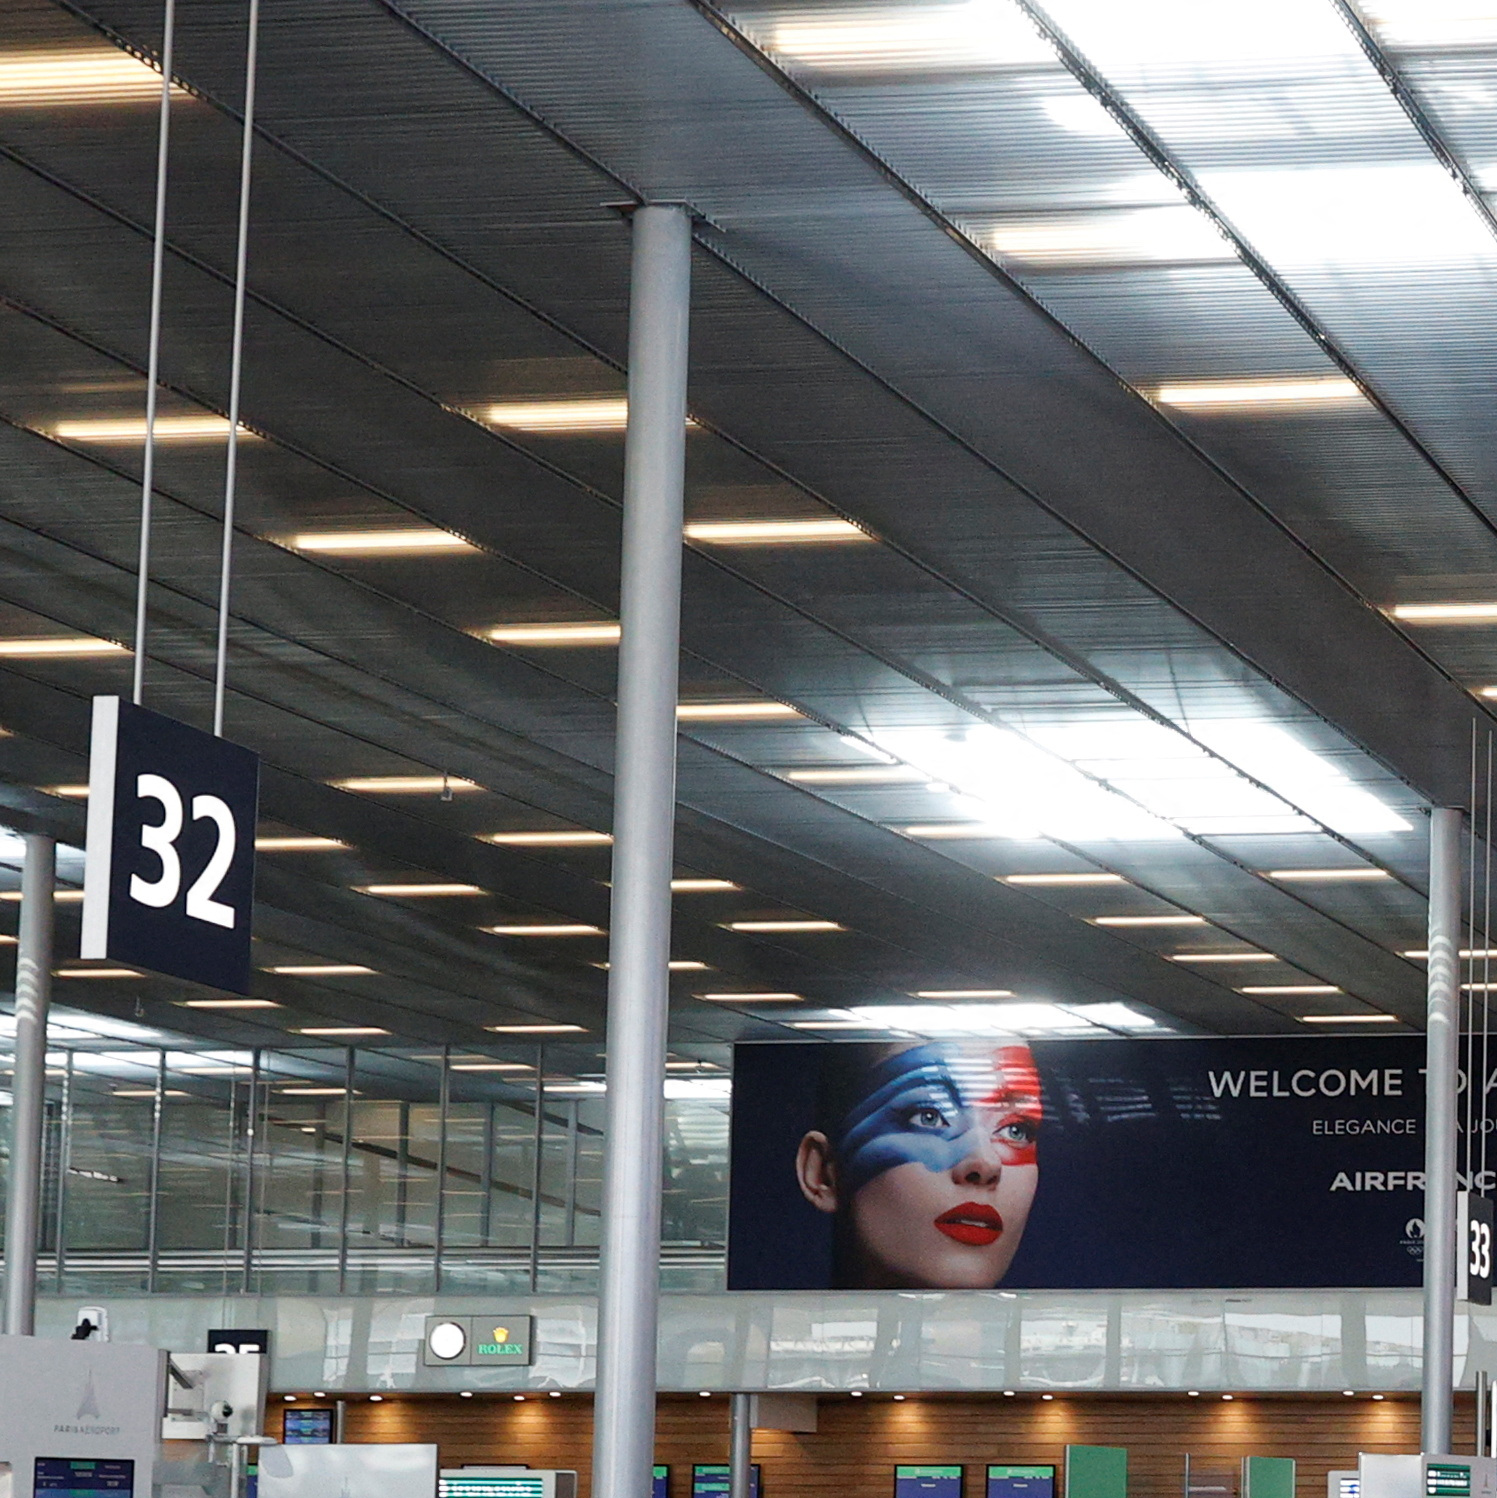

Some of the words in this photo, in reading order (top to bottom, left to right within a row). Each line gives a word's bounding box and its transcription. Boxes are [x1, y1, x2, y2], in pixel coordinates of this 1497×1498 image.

[130, 774, 235, 928] 32
[1208, 1068, 1403, 1098] WELCOME
[1313, 1118, 1416, 1135] ELEGANCE
[1469, 1219, 1491, 1279] 33
[478, 1344, 523, 1355] ROLEX
